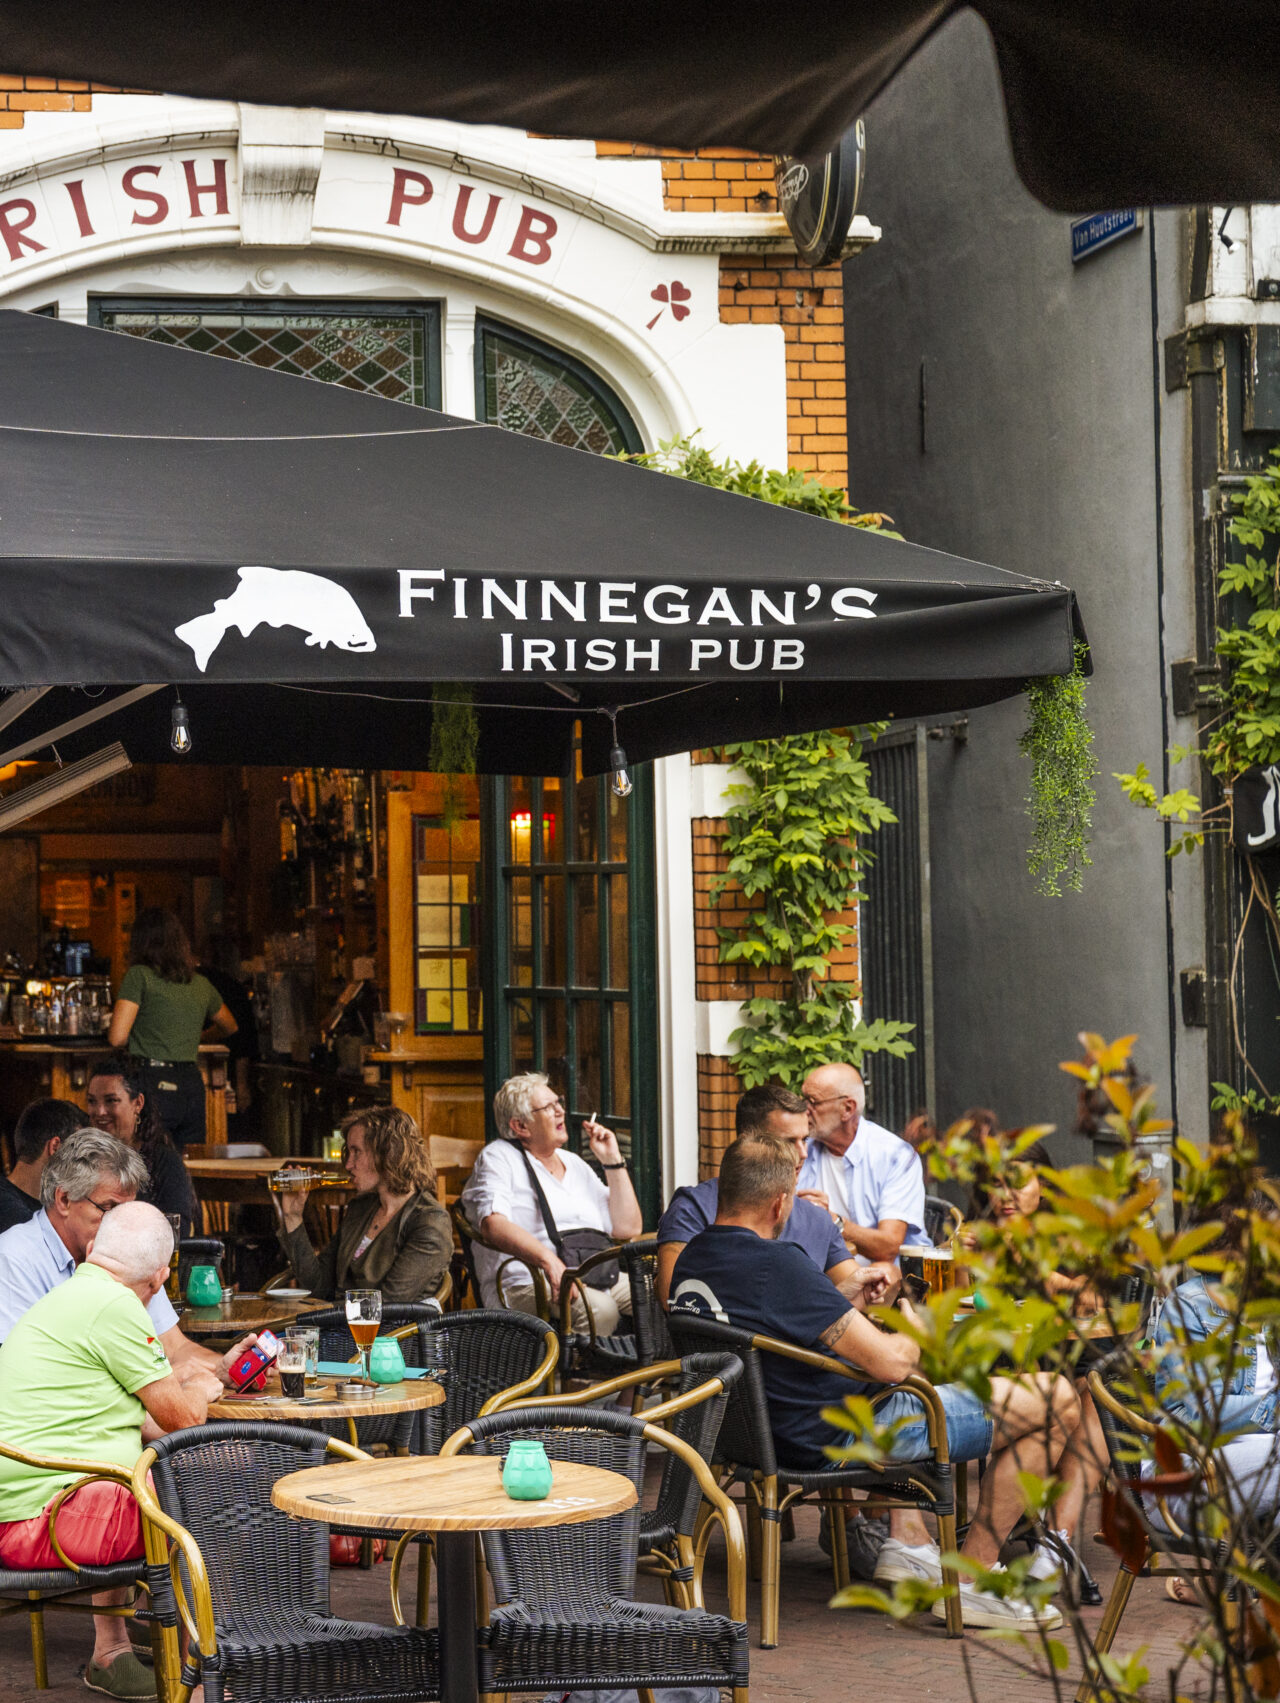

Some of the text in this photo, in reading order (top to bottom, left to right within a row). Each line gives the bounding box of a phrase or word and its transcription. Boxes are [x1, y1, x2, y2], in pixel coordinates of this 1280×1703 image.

[386, 167, 559, 266] PUB
[396, 568, 879, 627] FINNEGAN'S
[500, 632, 805, 673] IRISH PUB
